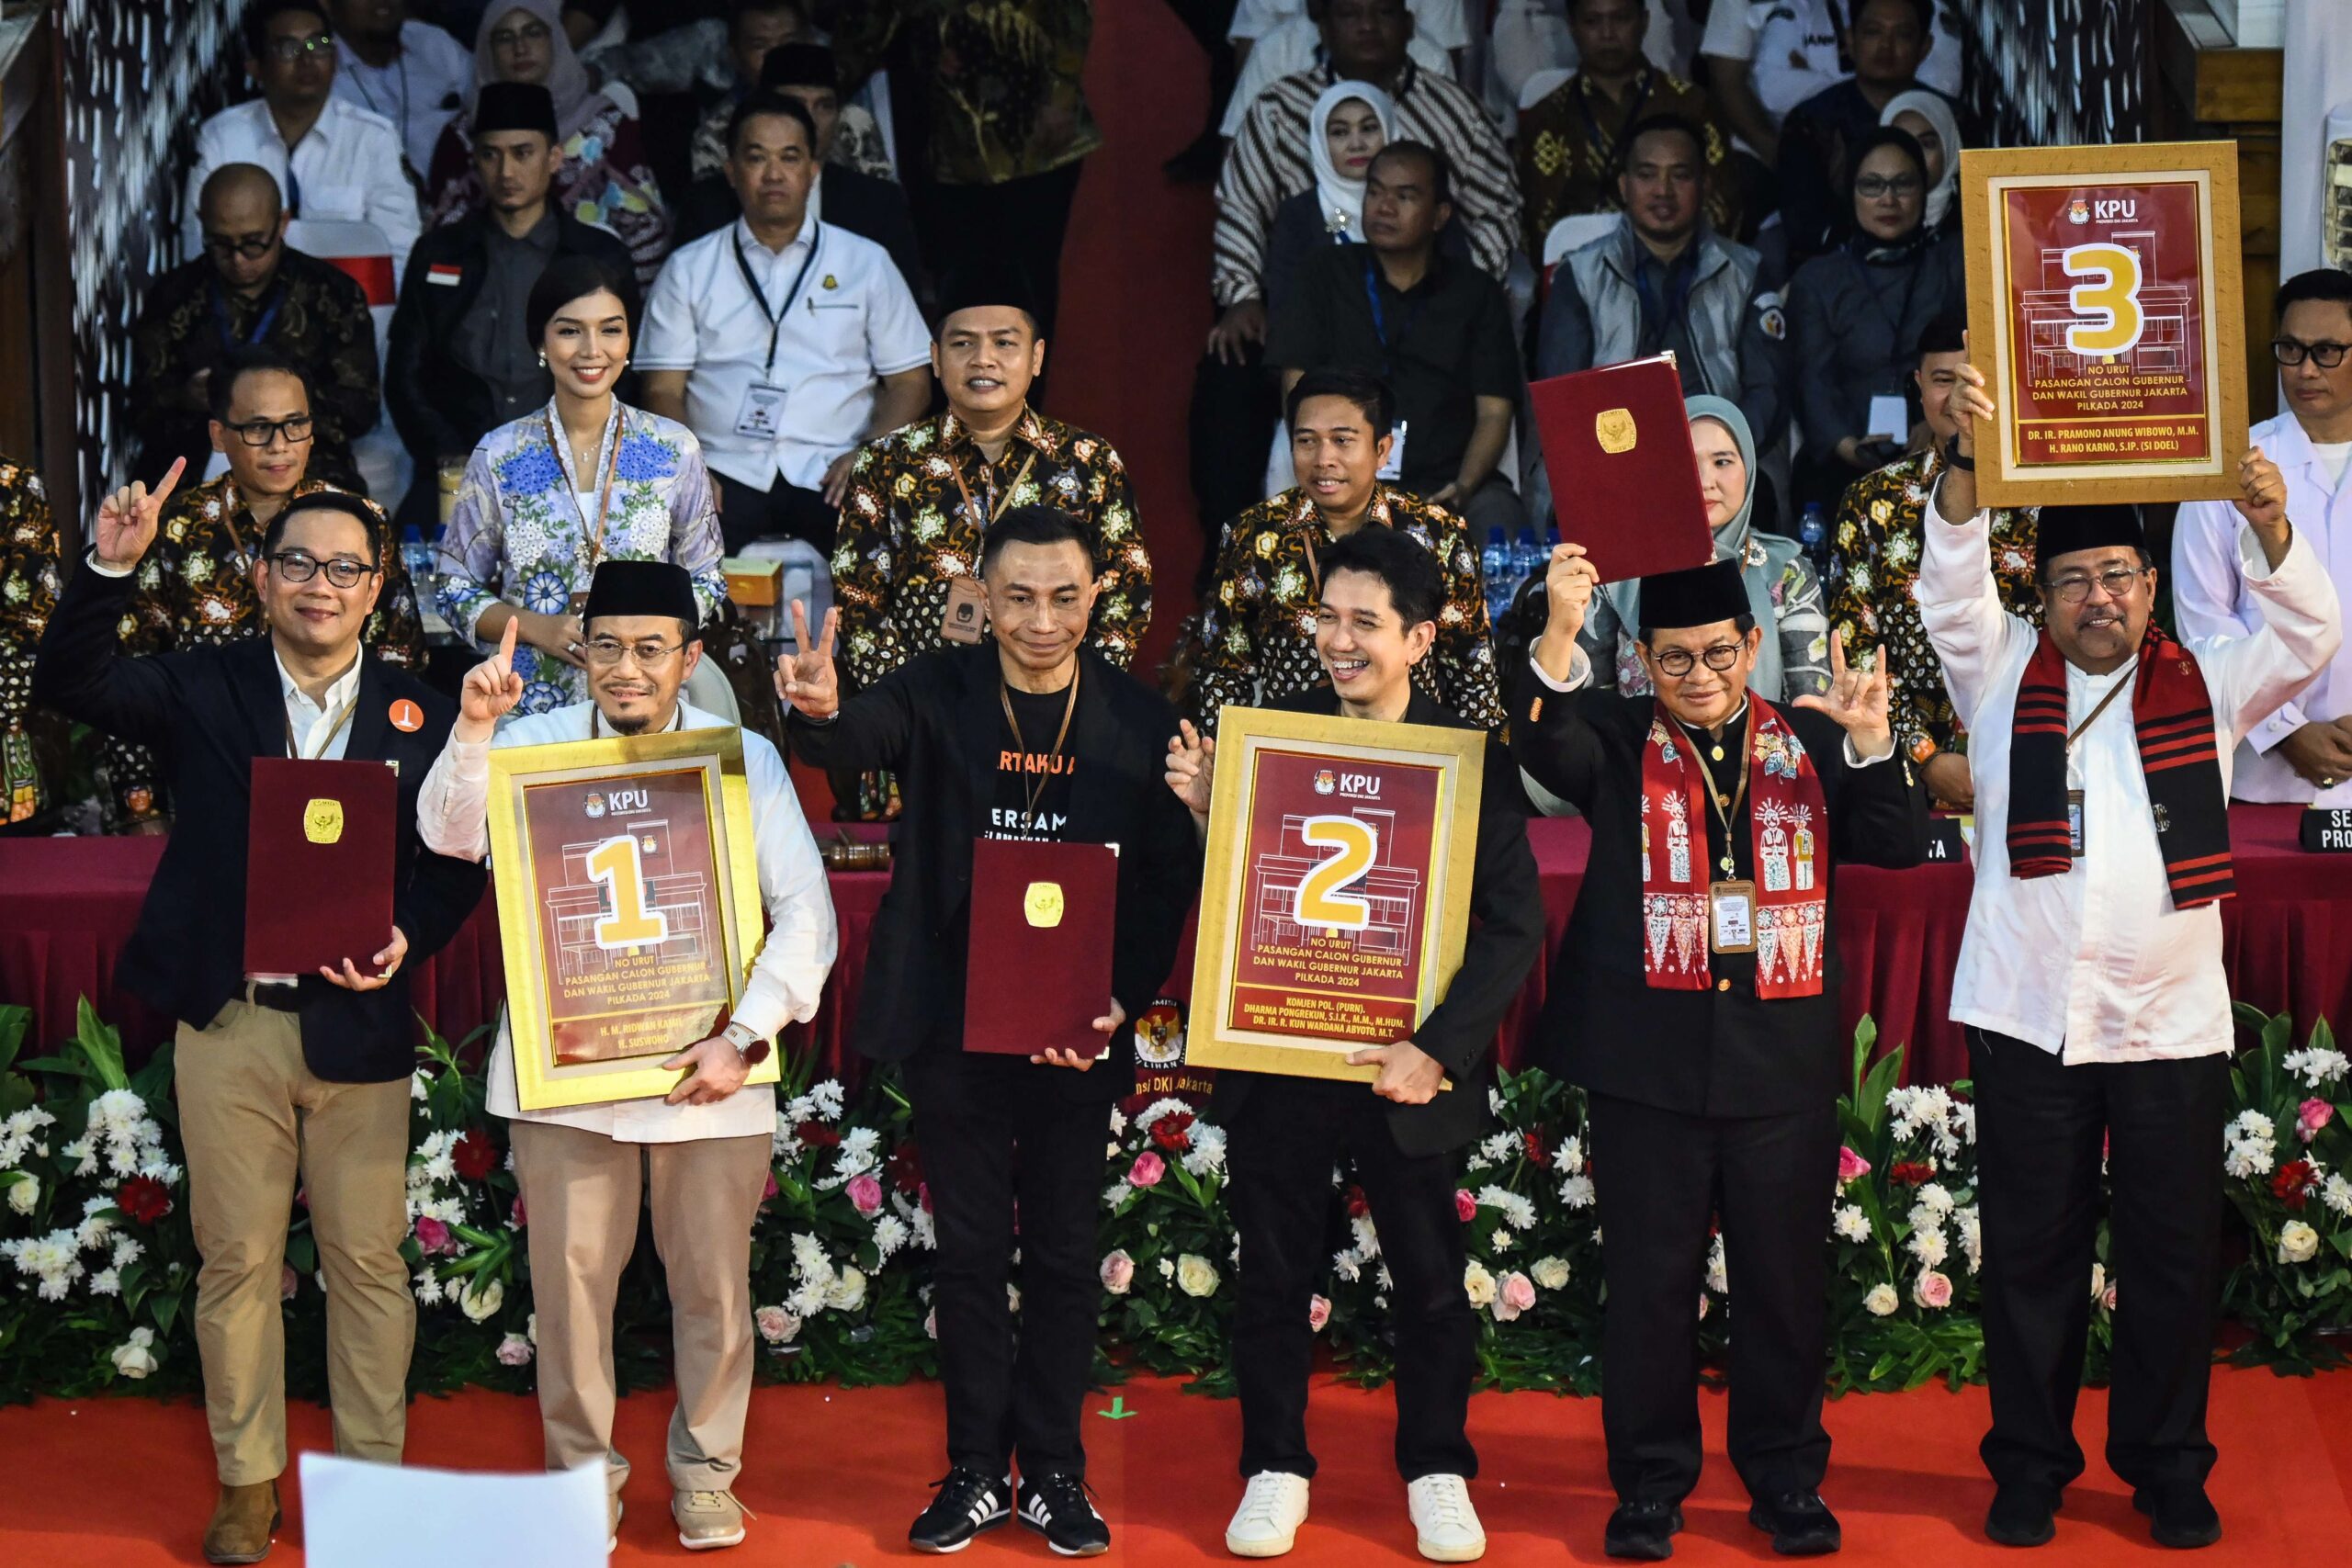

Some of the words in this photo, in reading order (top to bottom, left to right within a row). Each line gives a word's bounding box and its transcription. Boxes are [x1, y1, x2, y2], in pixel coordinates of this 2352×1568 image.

[2095, 199, 2136, 219] KPU
[2062, 243, 2144, 356] 3
[2087, 366, 2104, 375] NO
[2107, 365, 2130, 374] URUT
[2035, 378, 2091, 389] PASANGAN
[2094, 378, 2130, 387] CALON
[2132, 375, 2184, 385] GUBERNUR
[2032, 391, 2054, 400] DAN
[2057, 390, 2087, 400] WAKIL
[2089, 389, 2142, 399] GUBERNUR
[2143, 387, 2188, 397] JAKARTA
[2077, 401, 2119, 411] PILKADA
[2120, 400, 2143, 410] 2024
[2028, 431, 2043, 441] DR.
[2044, 430, 2057, 440] IR.
[2058, 429, 2102, 440] PRAMONO
[2102, 427, 2133, 438] ANUNG
[2134, 426, 2176, 437] WIBOWO,
[2177, 425, 2199, 435] M.M.
[2049, 444, 2059, 454] H.
[2060, 443, 2085, 453] RANO
[2086, 442, 2119, 453] KARNO,
[2120, 441, 2140, 452] S.IP.
[2141, 441, 2153, 452] (SI
[2154, 440, 2179, 451] DOEL)
[997, 750, 1063, 775] RTAKU
[1340, 773, 1381, 795] KPU
[608, 789, 649, 811] KPU
[2331, 809, 2352, 828] SE
[2322, 829, 2352, 849] PRO
[1293, 815, 1378, 931] 2
[586, 834, 669, 950] 1
[1310, 937, 1327, 948] NO
[1329, 940, 1351, 950] URUT
[615, 958, 630, 968] NO
[632, 955, 654, 966] URUT
[1257, 944, 1312, 958] PASANGAN
[1315, 950, 1350, 962] CALON
[1351, 953, 1402, 967] GUBERNUR
[565, 972, 618, 986] PASANGAN
[621, 967, 655, 979] CALON
[657, 962, 707, 975] GUBERNUR
[1253, 955, 1275, 966] DAN
[1277, 958, 1306, 970] WAKIL
[1308, 962, 1359, 975] GUBERNUR
[1361, 966, 1404, 979] JAKARTA
[563, 987, 585, 998] DAN
[587, 985, 616, 996] WAKIL
[617, 978, 667, 992] GUBERNUR
[670, 973, 711, 986] JAKARTA
[1295, 972, 1335, 985] PILKADA
[1337, 976, 1360, 987] 2024
[607, 992, 647, 1005] PILKADA
[648, 989, 671, 1001] 2024
[1286, 997, 1317, 1009] KOMJEN
[1317, 999, 1335, 1010] POL.
[1336, 1002, 1366, 1014] (PURN).
[1244, 1003, 1277, 1016] DHARMA
[1278, 1008, 1327, 1021] PONGREKUN,
[1375, 1016, 1406, 1029] M.HUM.
[600, 1026, 610, 1037] H.
[611, 1024, 621, 1035] M.
[623, 1020, 656, 1034] RIDWAN
[1253, 1015, 1267, 1025] DR.
[1268, 1016, 1279, 1026] IR.
[1280, 1018, 1288, 1028] R.
[1289, 1019, 1306, 1030] KUN
[1306, 1021, 1345, 1033] WARDANA
[1345, 1024, 1377, 1037] ABYOTO,
[1378, 1028, 1395, 1038] M.T.
[618, 1038, 628, 1049] H.
[628, 1033, 670, 1048] SUSWONO
[1154, 1077, 1172, 1092] DKI
